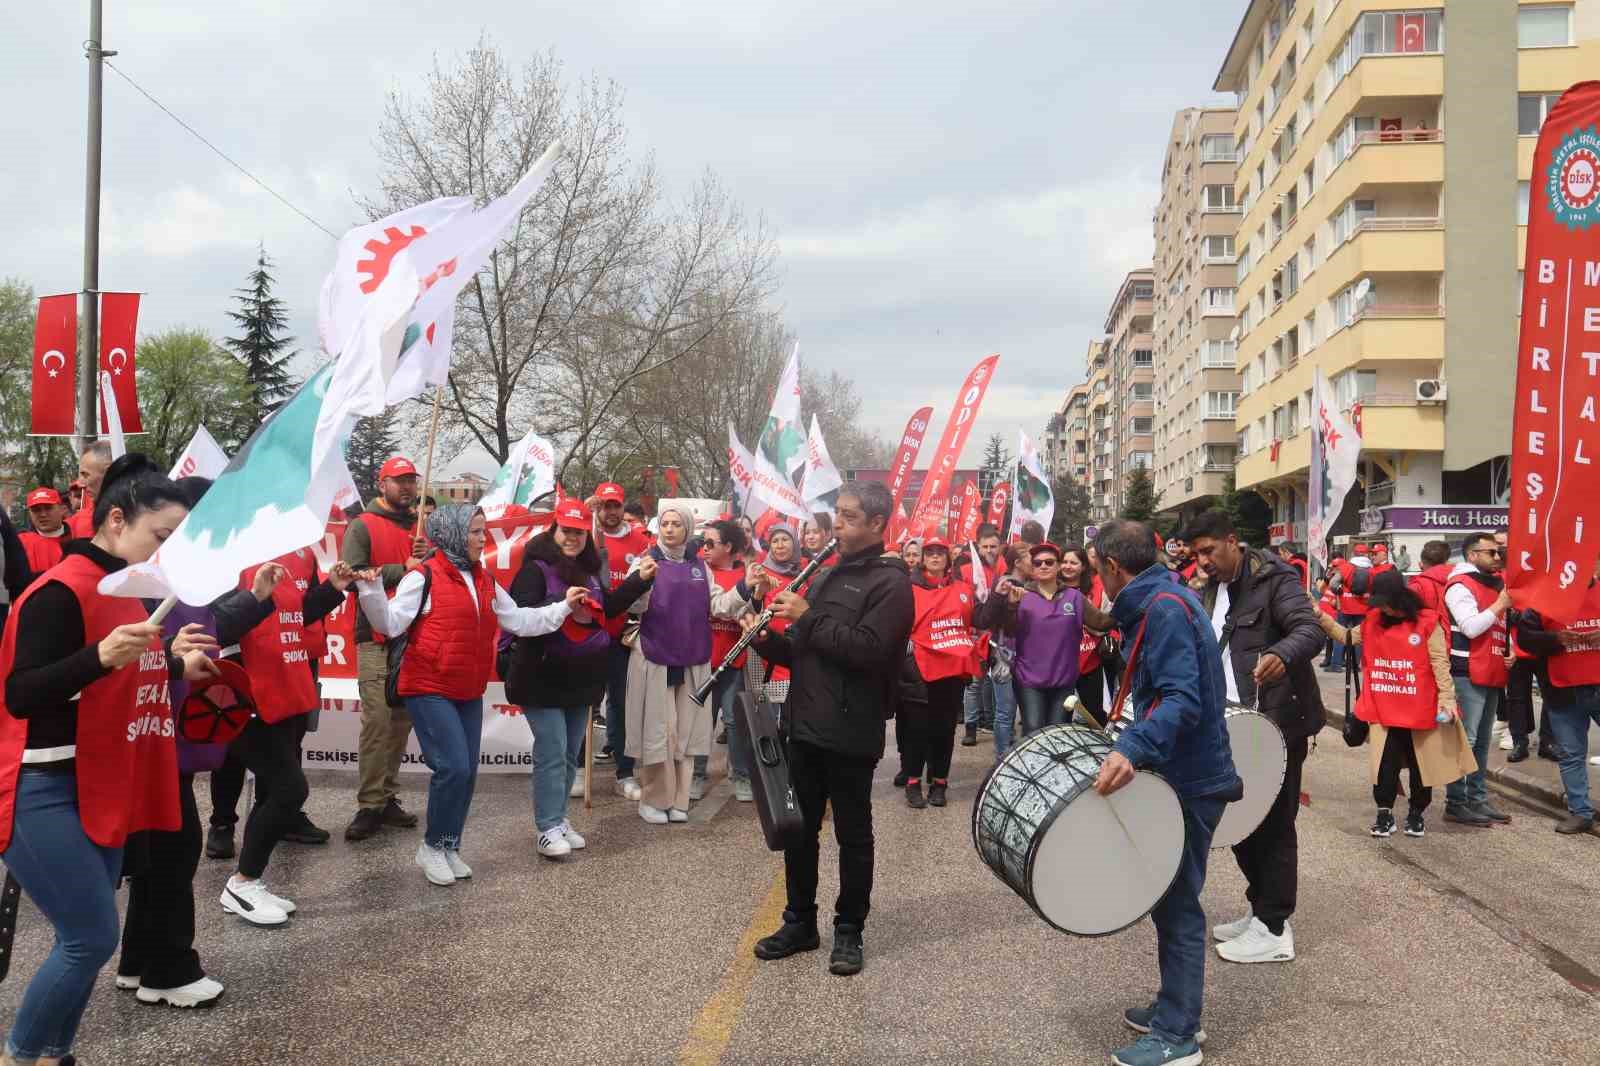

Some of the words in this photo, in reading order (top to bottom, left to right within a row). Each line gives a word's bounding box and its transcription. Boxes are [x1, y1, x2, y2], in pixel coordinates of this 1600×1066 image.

[1569, 168, 1592, 184] DİSK
[1519, 259, 1556, 571] BİRLEŞİK
[727, 447, 752, 488] DİSK
[1421, 510, 1461, 526] Hacı
[1464, 510, 1509, 526] Hasa
[1559, 516, 1584, 590] İŞ
[1374, 658, 1413, 671] BİRLEŞİK
[1371, 671, 1398, 681] METAL
[1371, 683, 1417, 695] SENDİKASI
[306, 749, 359, 764] ESKİŞE
[480, 751, 533, 766] İLCİLİĞ
